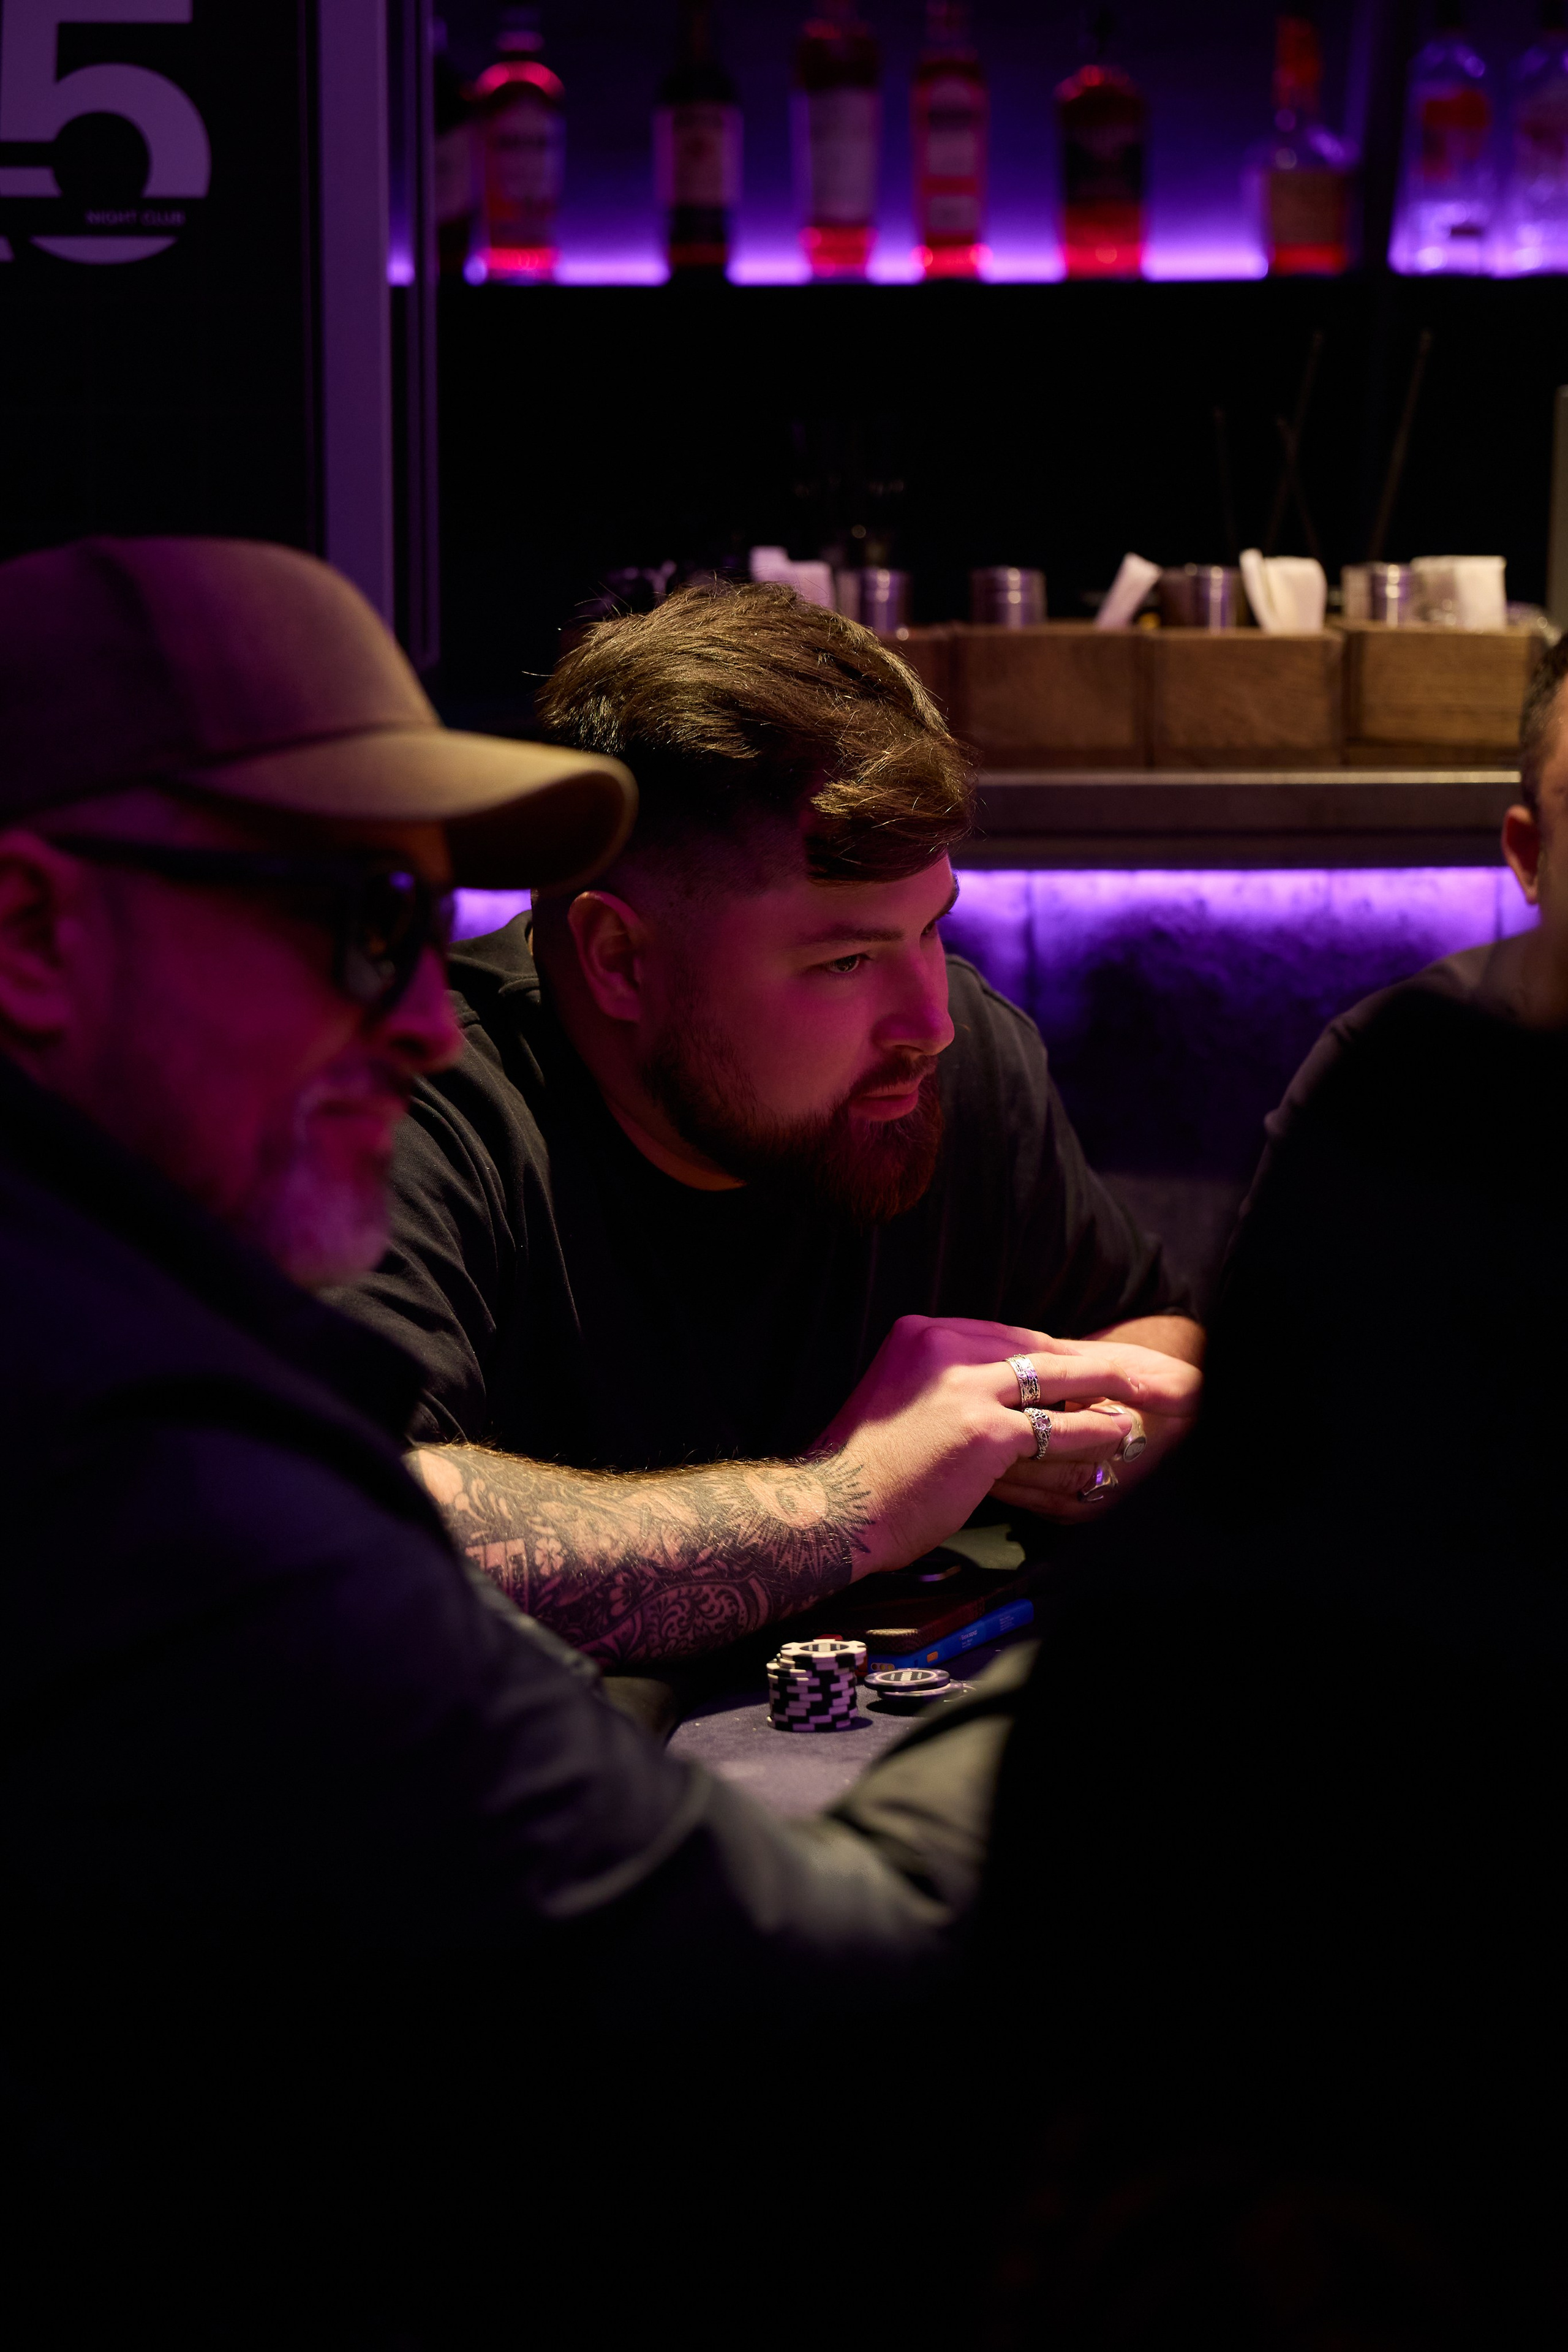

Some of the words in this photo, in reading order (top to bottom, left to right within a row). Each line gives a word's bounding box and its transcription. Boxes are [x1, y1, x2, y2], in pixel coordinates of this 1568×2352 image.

[0, 0, 213, 266] 5
[85, 209, 137, 225] NIGHT
[140, 209, 185, 227] CLUB
